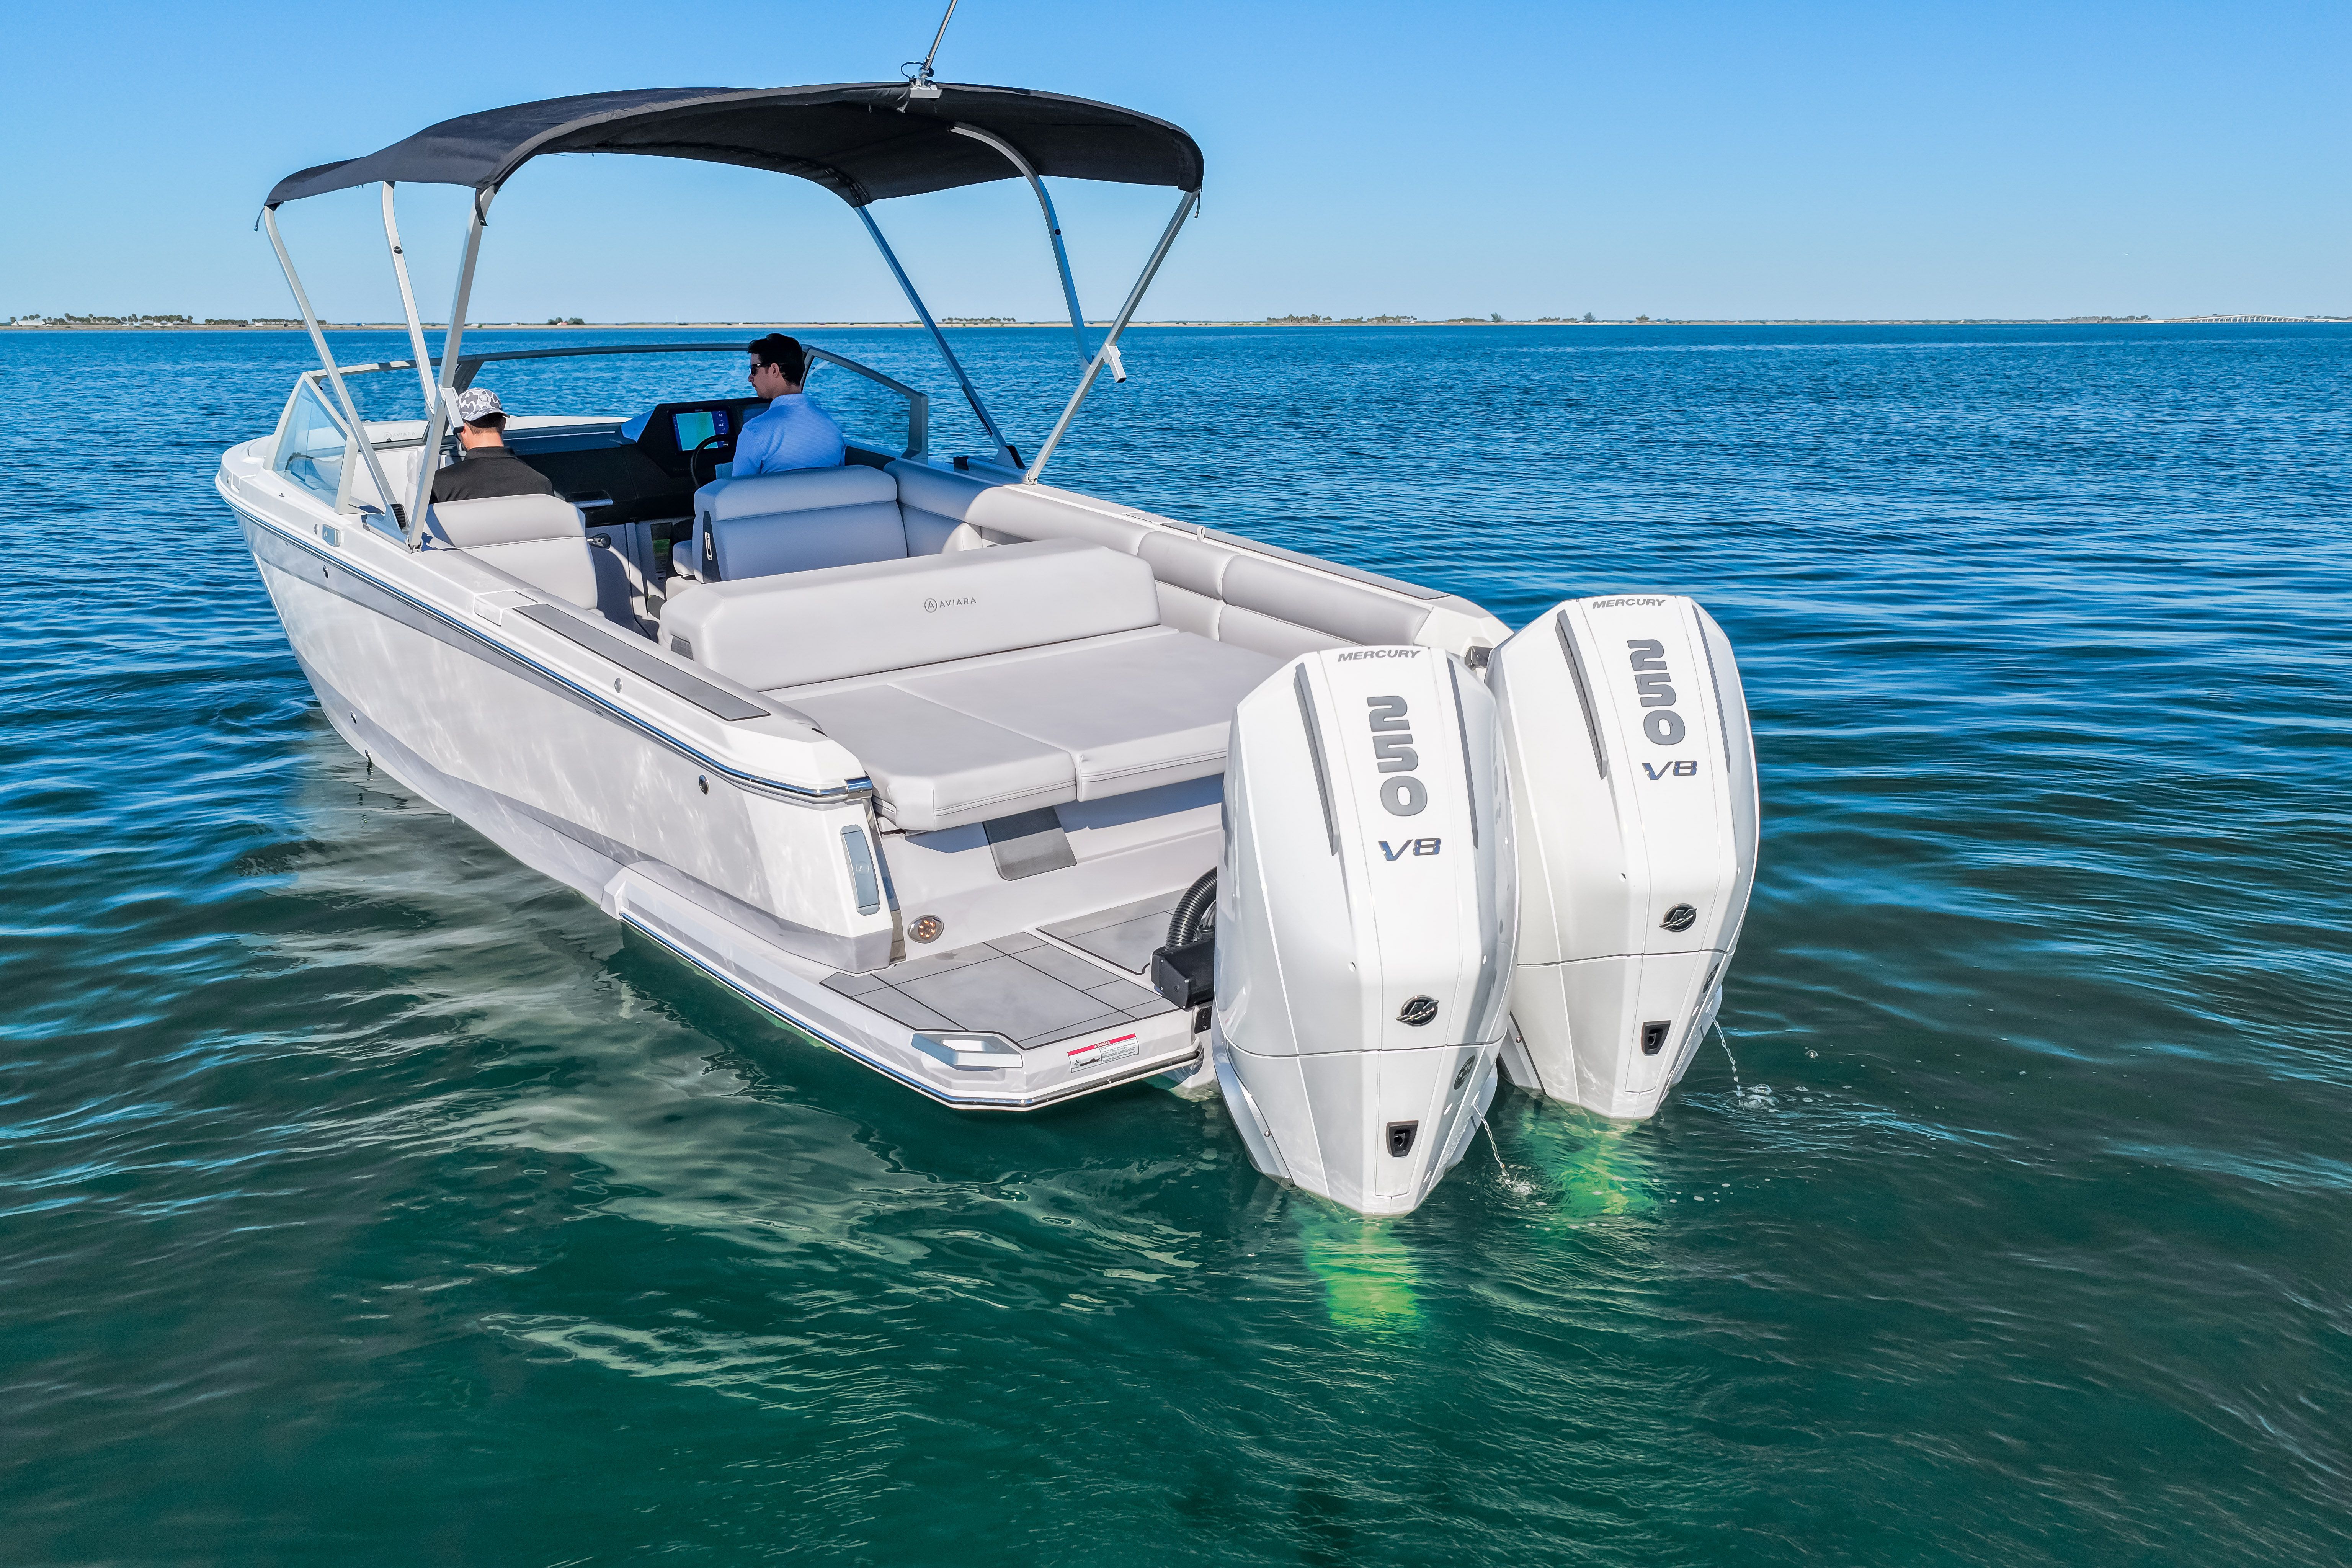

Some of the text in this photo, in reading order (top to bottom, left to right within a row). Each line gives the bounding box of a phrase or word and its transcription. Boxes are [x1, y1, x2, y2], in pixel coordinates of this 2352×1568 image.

[939, 597, 976, 608] AVIARA
[1592, 599, 1666, 609] MERCURY
[1338, 650, 1421, 662] MERCURY
[1627, 639, 1685, 745] 250
[1367, 696, 1427, 816] 250
[1642, 760, 1697, 780] V8
[1379, 838, 1441, 861] V8
